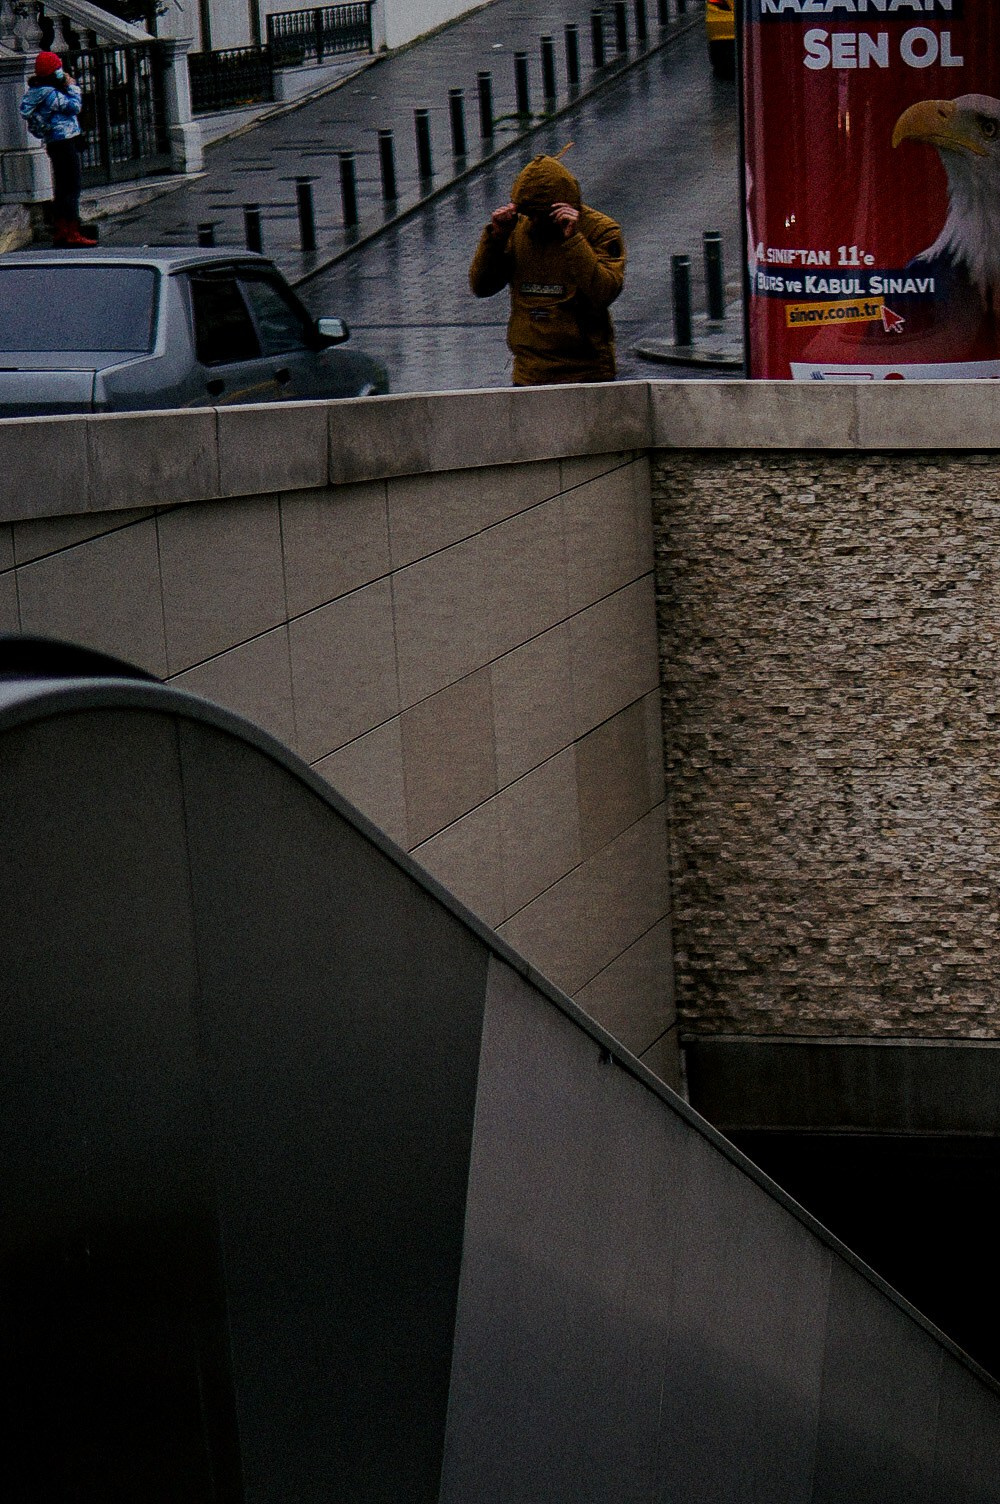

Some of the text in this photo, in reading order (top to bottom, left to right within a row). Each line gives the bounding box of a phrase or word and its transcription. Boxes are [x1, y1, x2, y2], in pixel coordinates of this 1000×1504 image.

[803, 26, 965, 70] SEN OL
[837, 245, 876, 266] 11'e
[757, 272, 784, 293] BURS
[785, 279, 803, 293] ve
[805, 275, 866, 294] KABUL
[789, 302, 879, 324] sinav.com.tr
